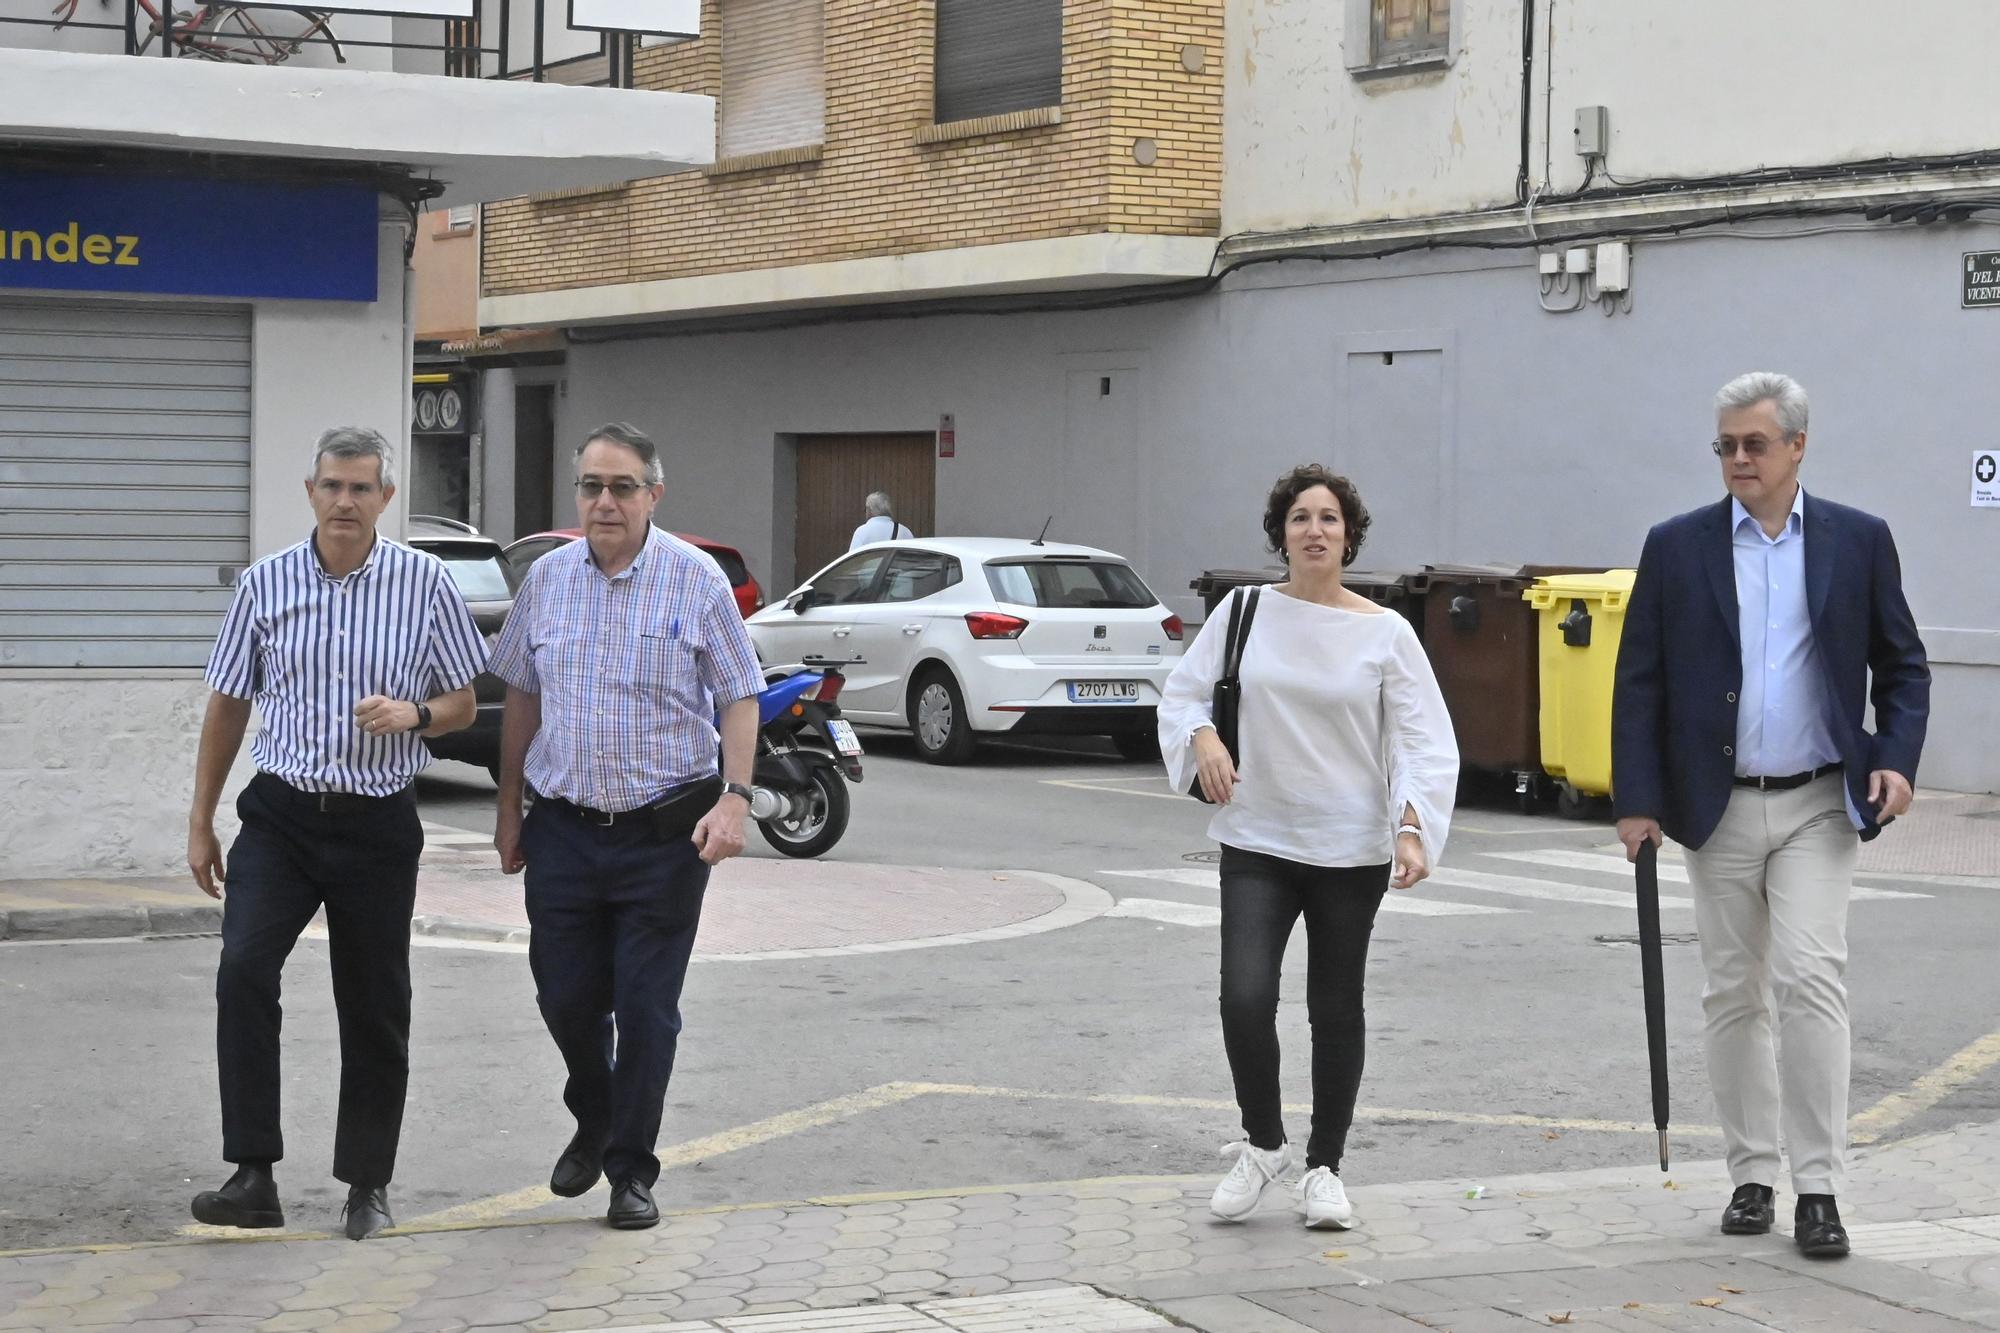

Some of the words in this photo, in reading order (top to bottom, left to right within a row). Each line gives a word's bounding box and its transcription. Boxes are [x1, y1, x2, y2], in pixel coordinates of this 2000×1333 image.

[0, 221, 140, 266] ndez
[1971, 270, 1993, 284] D'EL
[1085, 643, 1113, 652] Ibiza
[1077, 683, 1109, 697] 2707
[1112, 683, 1136, 697] LWG
